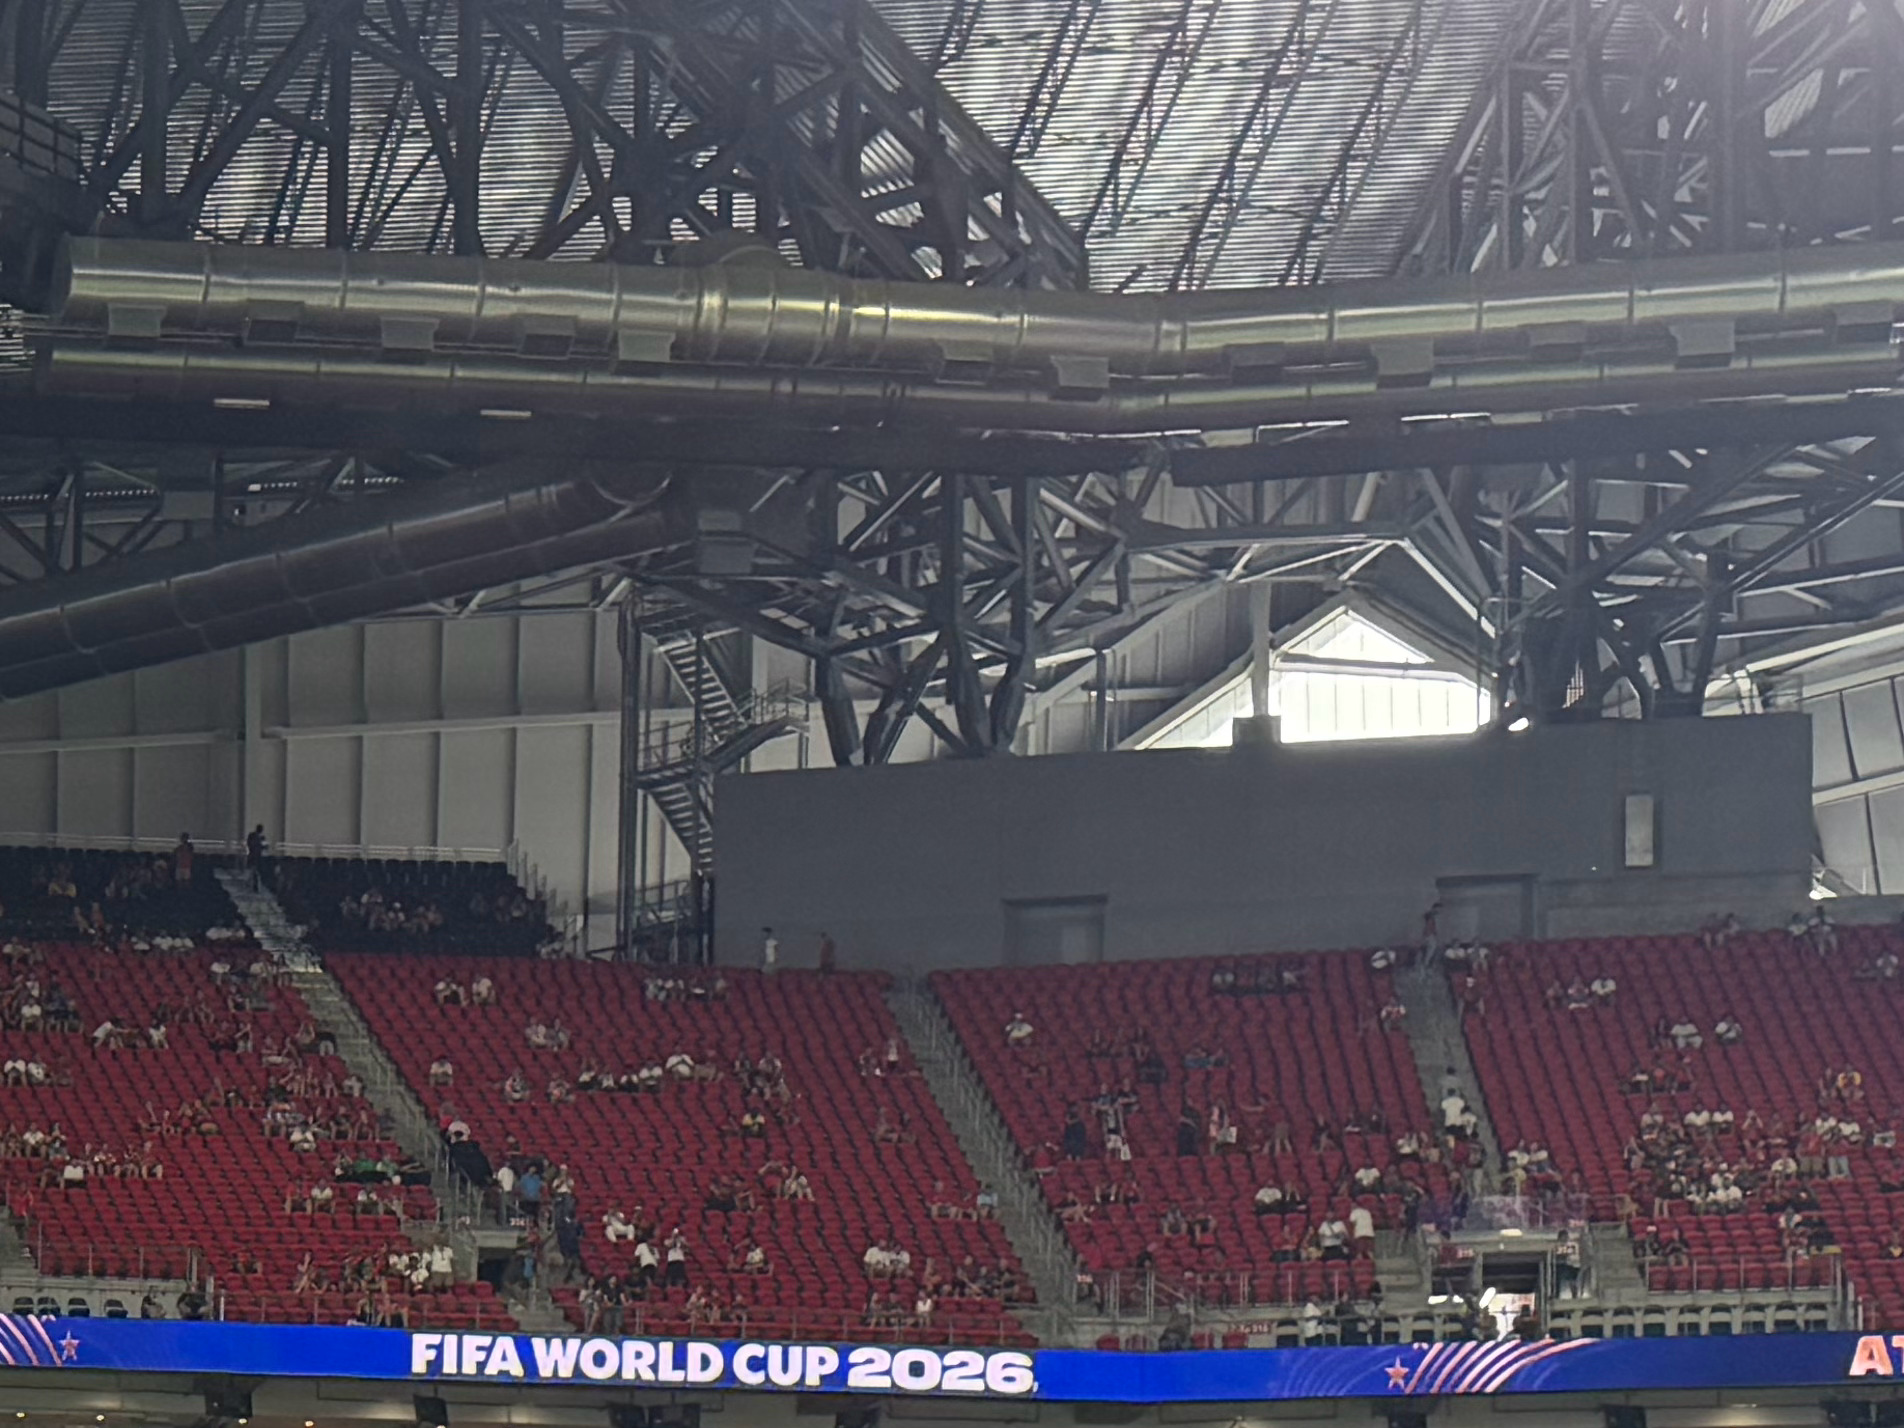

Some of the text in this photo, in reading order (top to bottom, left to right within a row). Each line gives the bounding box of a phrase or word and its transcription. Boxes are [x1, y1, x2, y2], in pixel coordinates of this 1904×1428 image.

[412, 1334, 1034, 1393] FIFA WORLD CUP 2026
